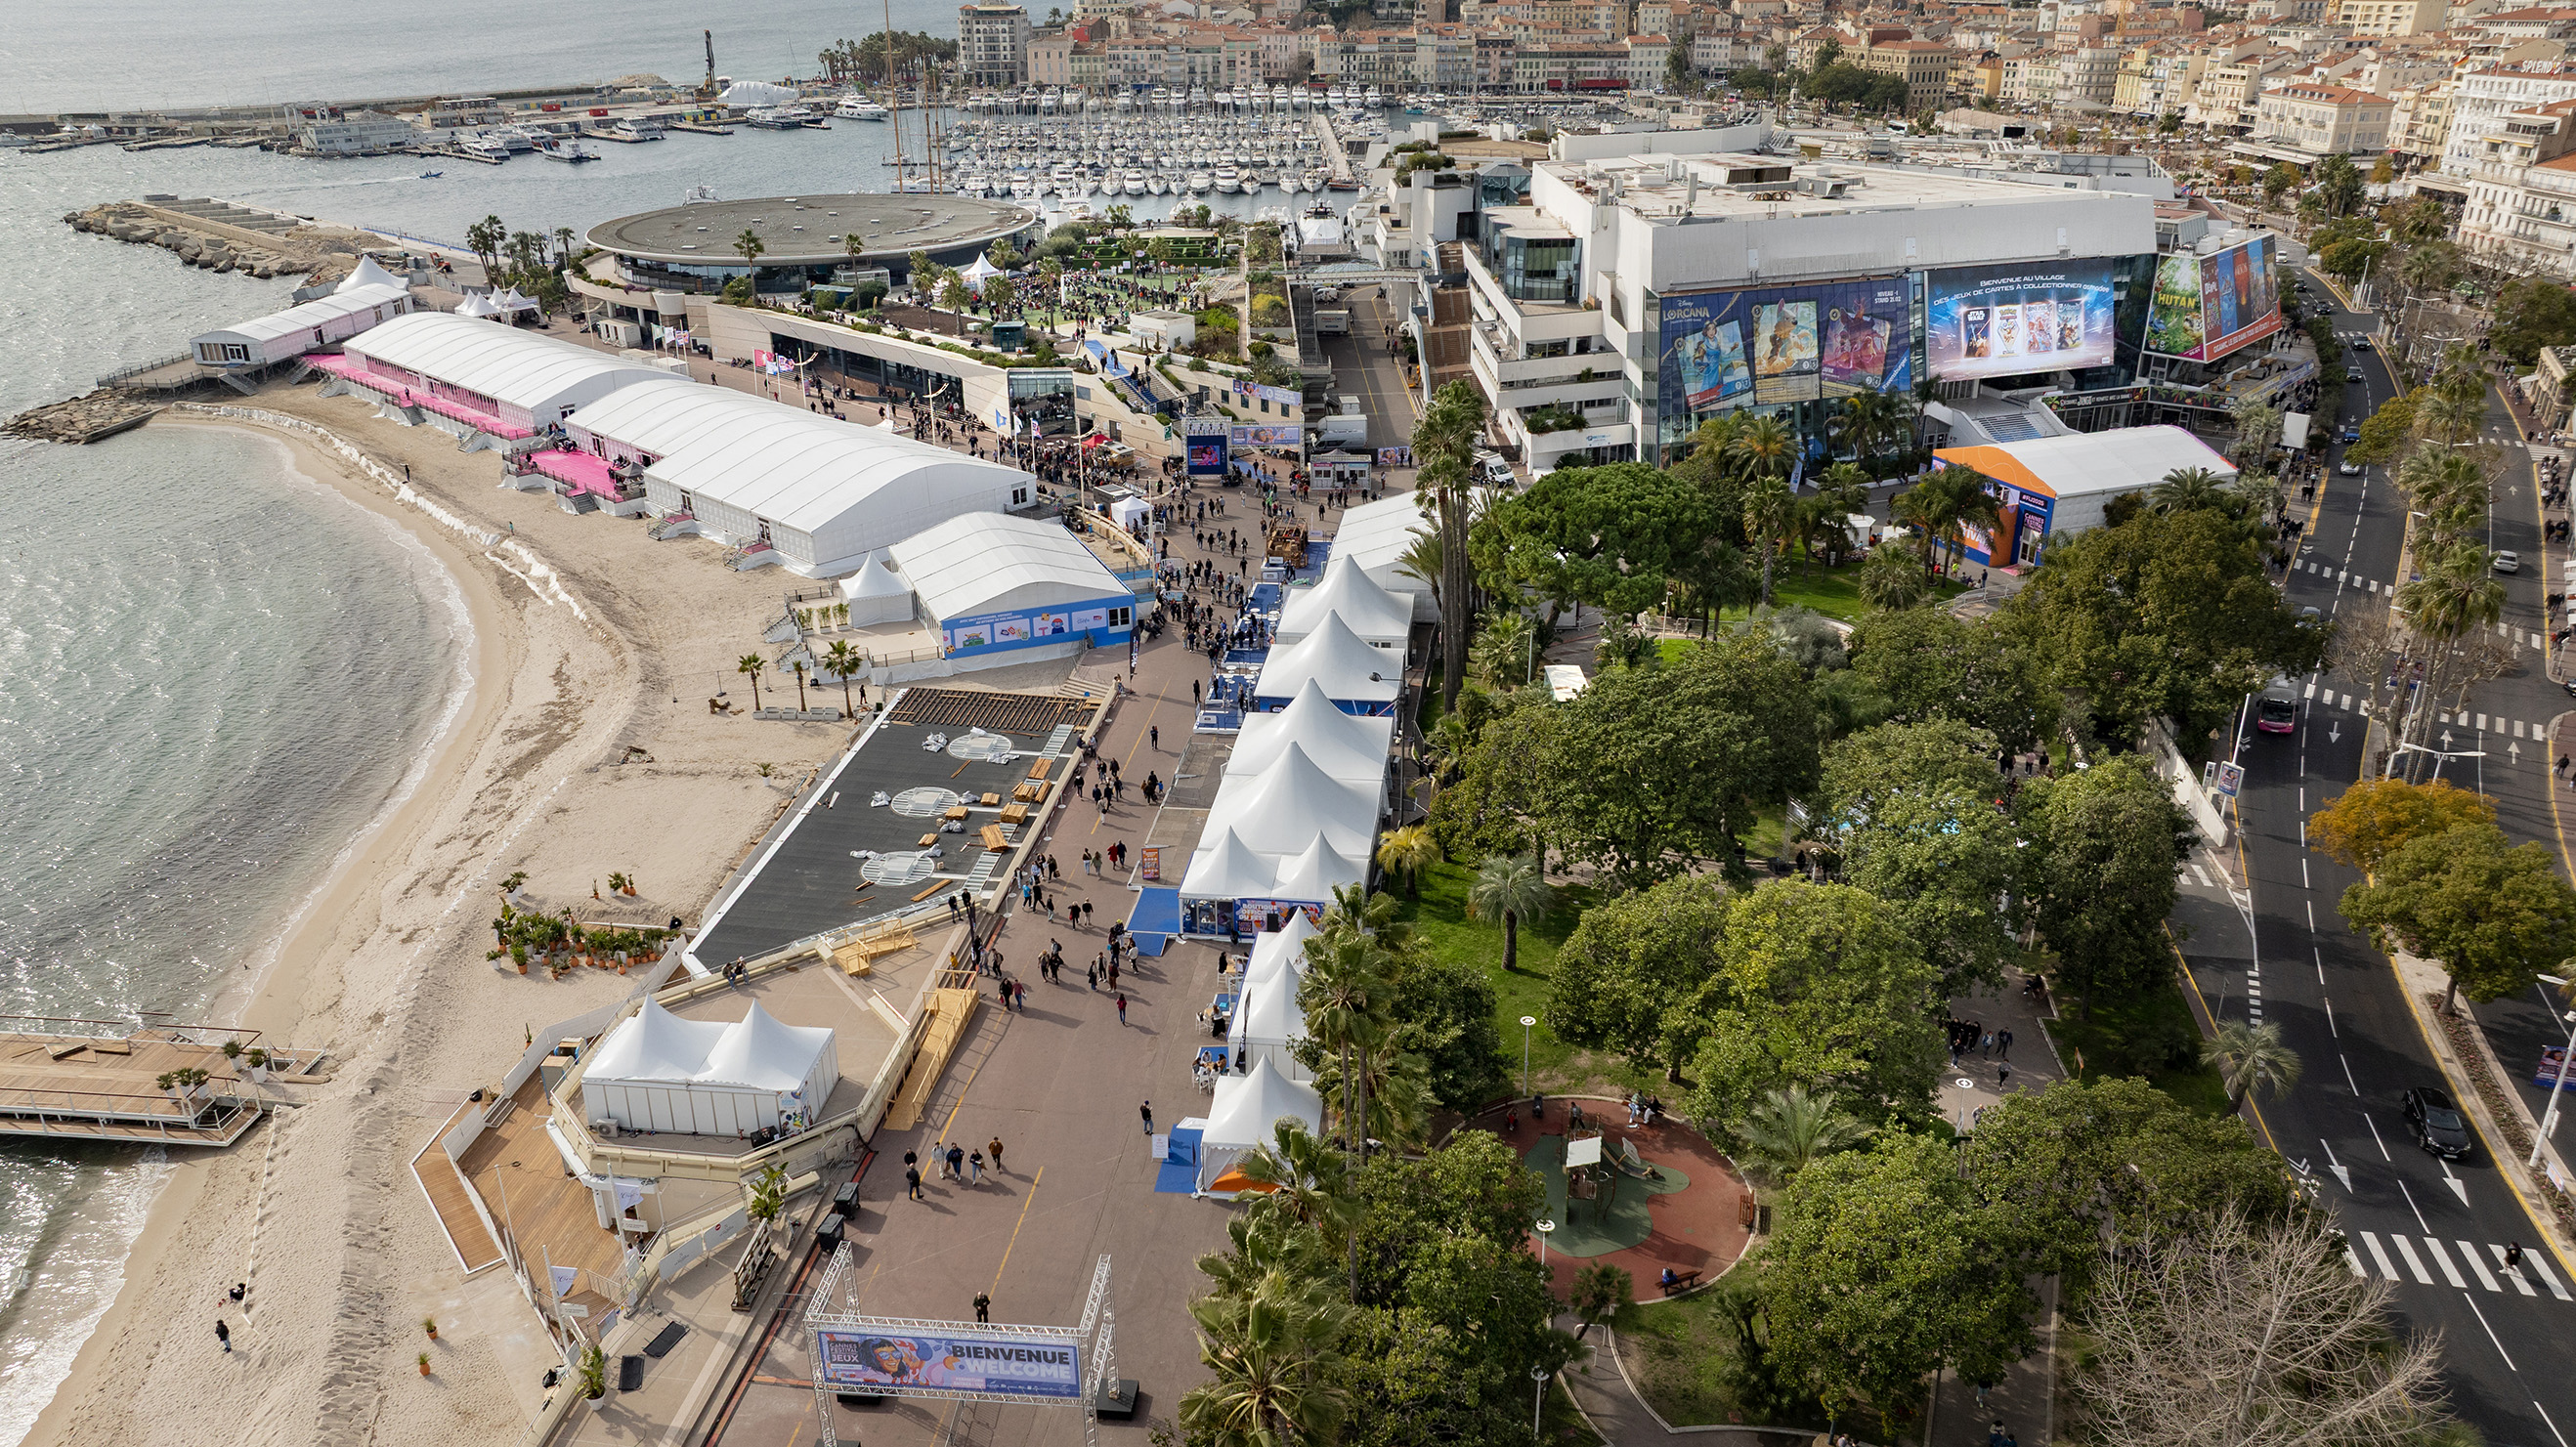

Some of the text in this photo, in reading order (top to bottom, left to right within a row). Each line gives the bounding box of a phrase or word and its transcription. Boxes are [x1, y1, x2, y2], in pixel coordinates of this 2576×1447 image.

[2521, 60, 2561, 74] SPLENDD
[1980, 277, 2022, 286] BIENVENUE
[1934, 297, 1950, 306] DES
[1951, 291, 1972, 302] JEUX
[1985, 285, 2015, 294] CARTES
[2082, 284, 2110, 293] asmodee
[2158, 293, 2197, 309] HUTAN
[1662, 307, 1710, 321] LORCANA
[1882, 357, 1908, 390] Ravensburger
[952, 1345, 1070, 1366] BIENVENUE
[966, 1359, 1071, 1379] WELCOME
